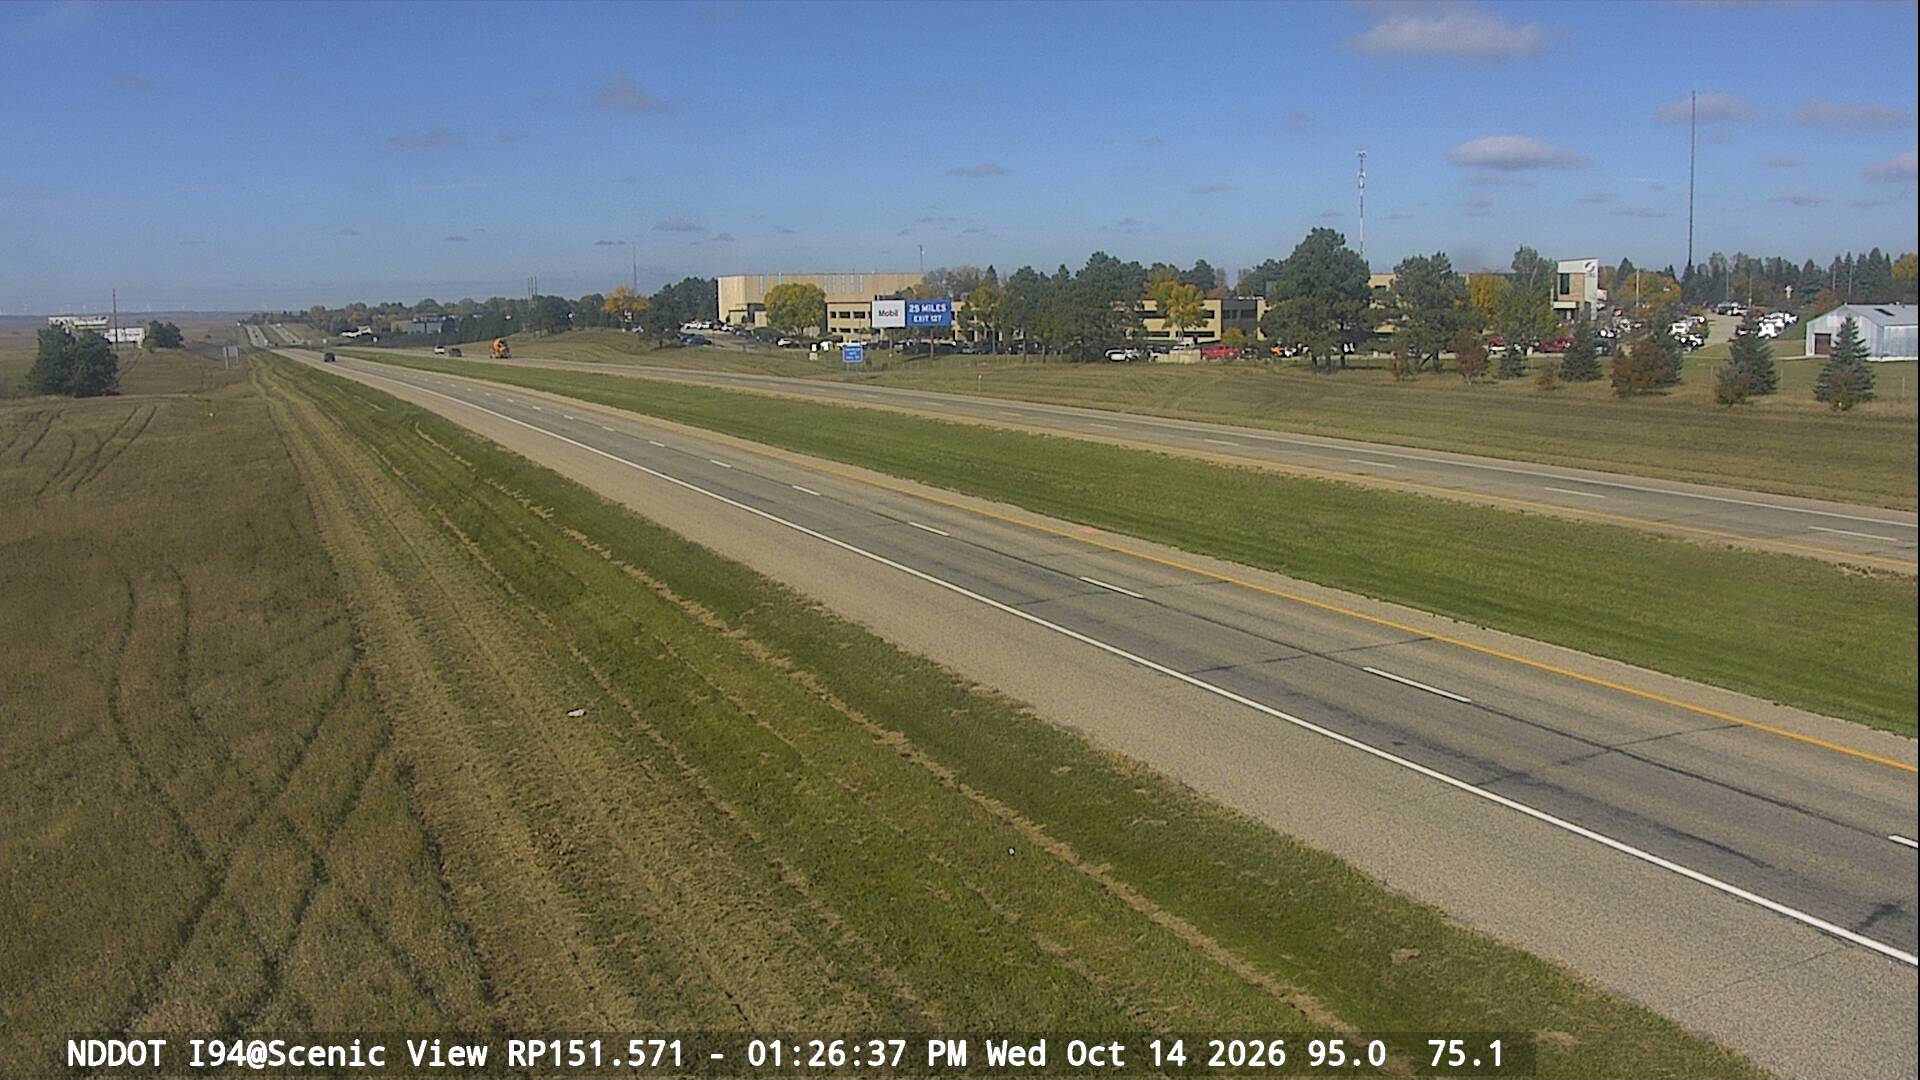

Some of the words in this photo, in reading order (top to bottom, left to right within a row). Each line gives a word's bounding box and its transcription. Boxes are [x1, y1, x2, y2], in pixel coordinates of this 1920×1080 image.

[921, 303, 947, 313] MILES
[878, 309, 899, 317] Mobil
[913, 314, 929, 323] EXIT
